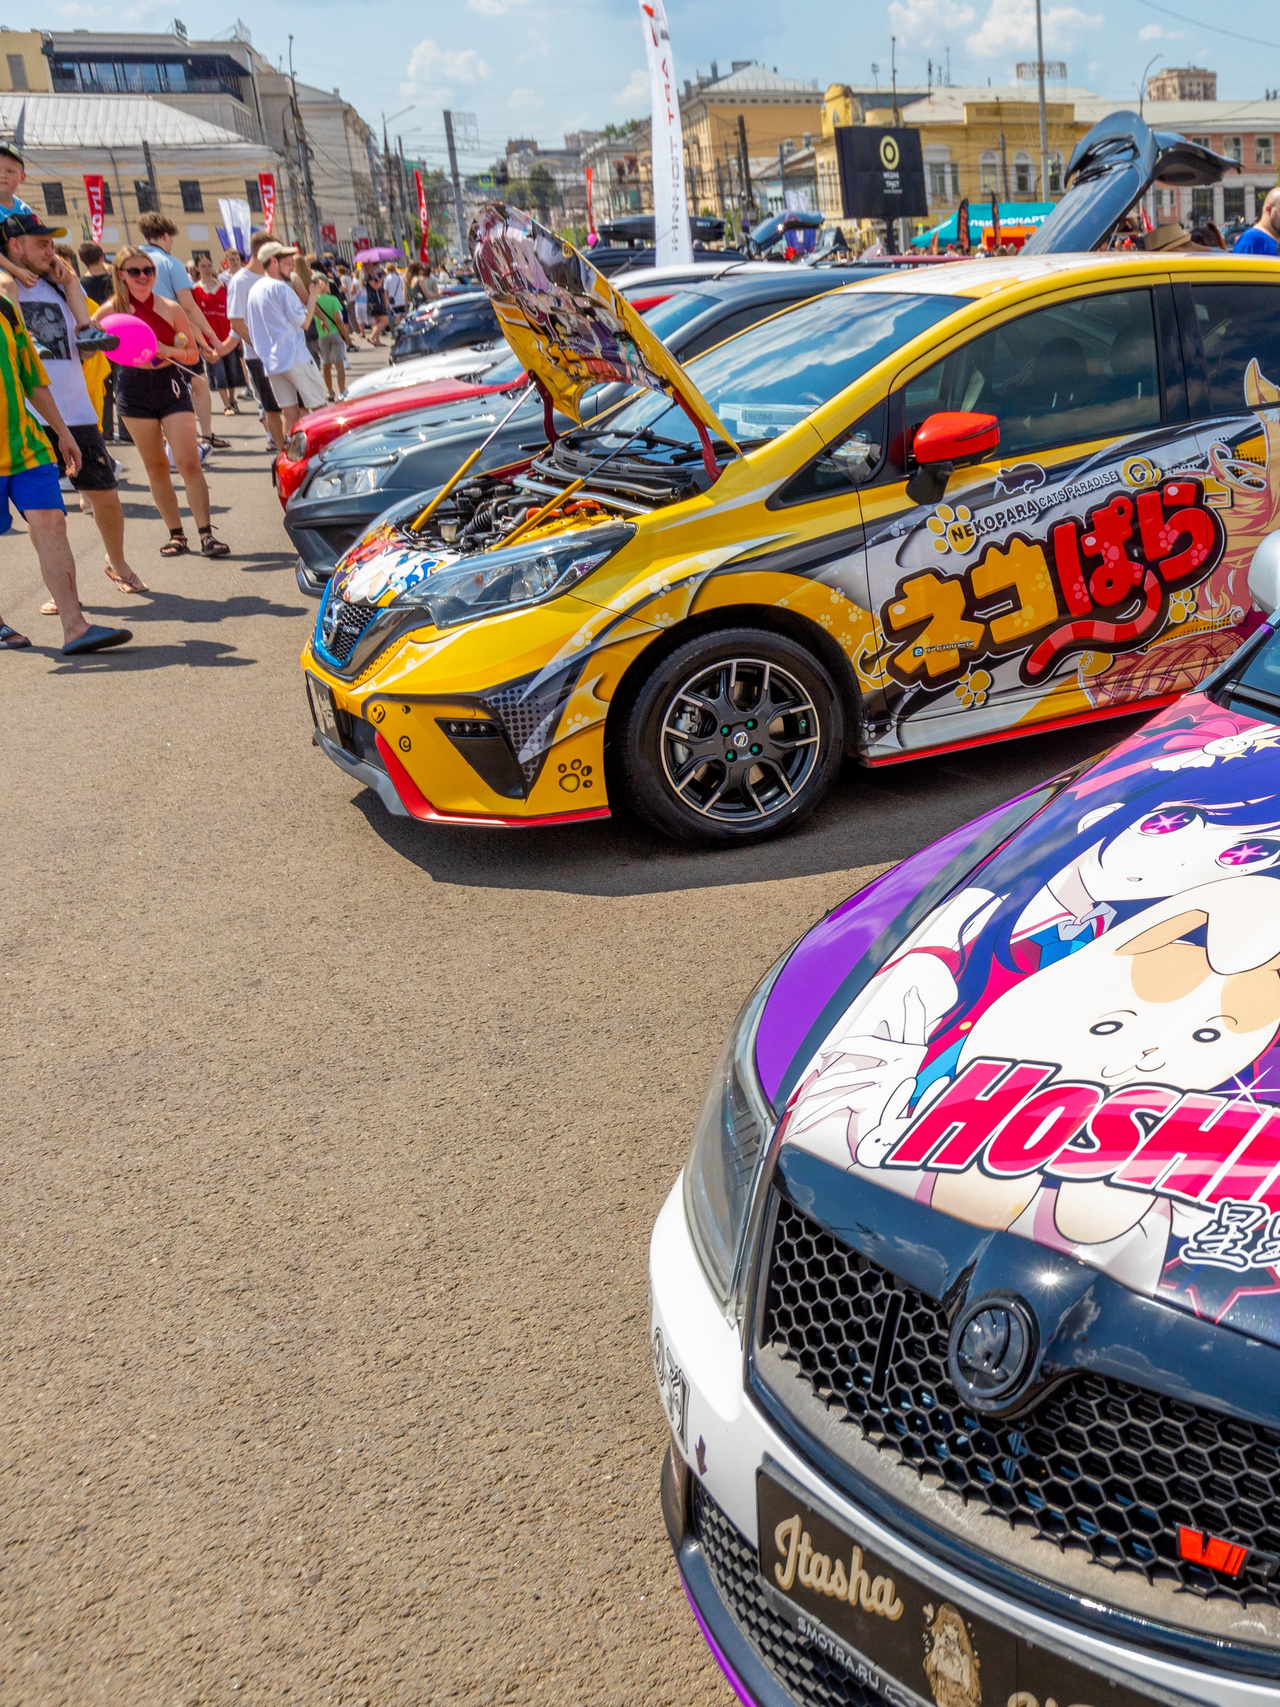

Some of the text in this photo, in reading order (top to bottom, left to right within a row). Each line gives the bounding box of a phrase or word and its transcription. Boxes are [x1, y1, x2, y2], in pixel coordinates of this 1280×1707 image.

[951, 470, 1118, 543] NEKOPARA CATS PARADISE
[887, 482, 1216, 678] ネコぱら
[797, 1617, 880, 1686] SMOTRA.RU
